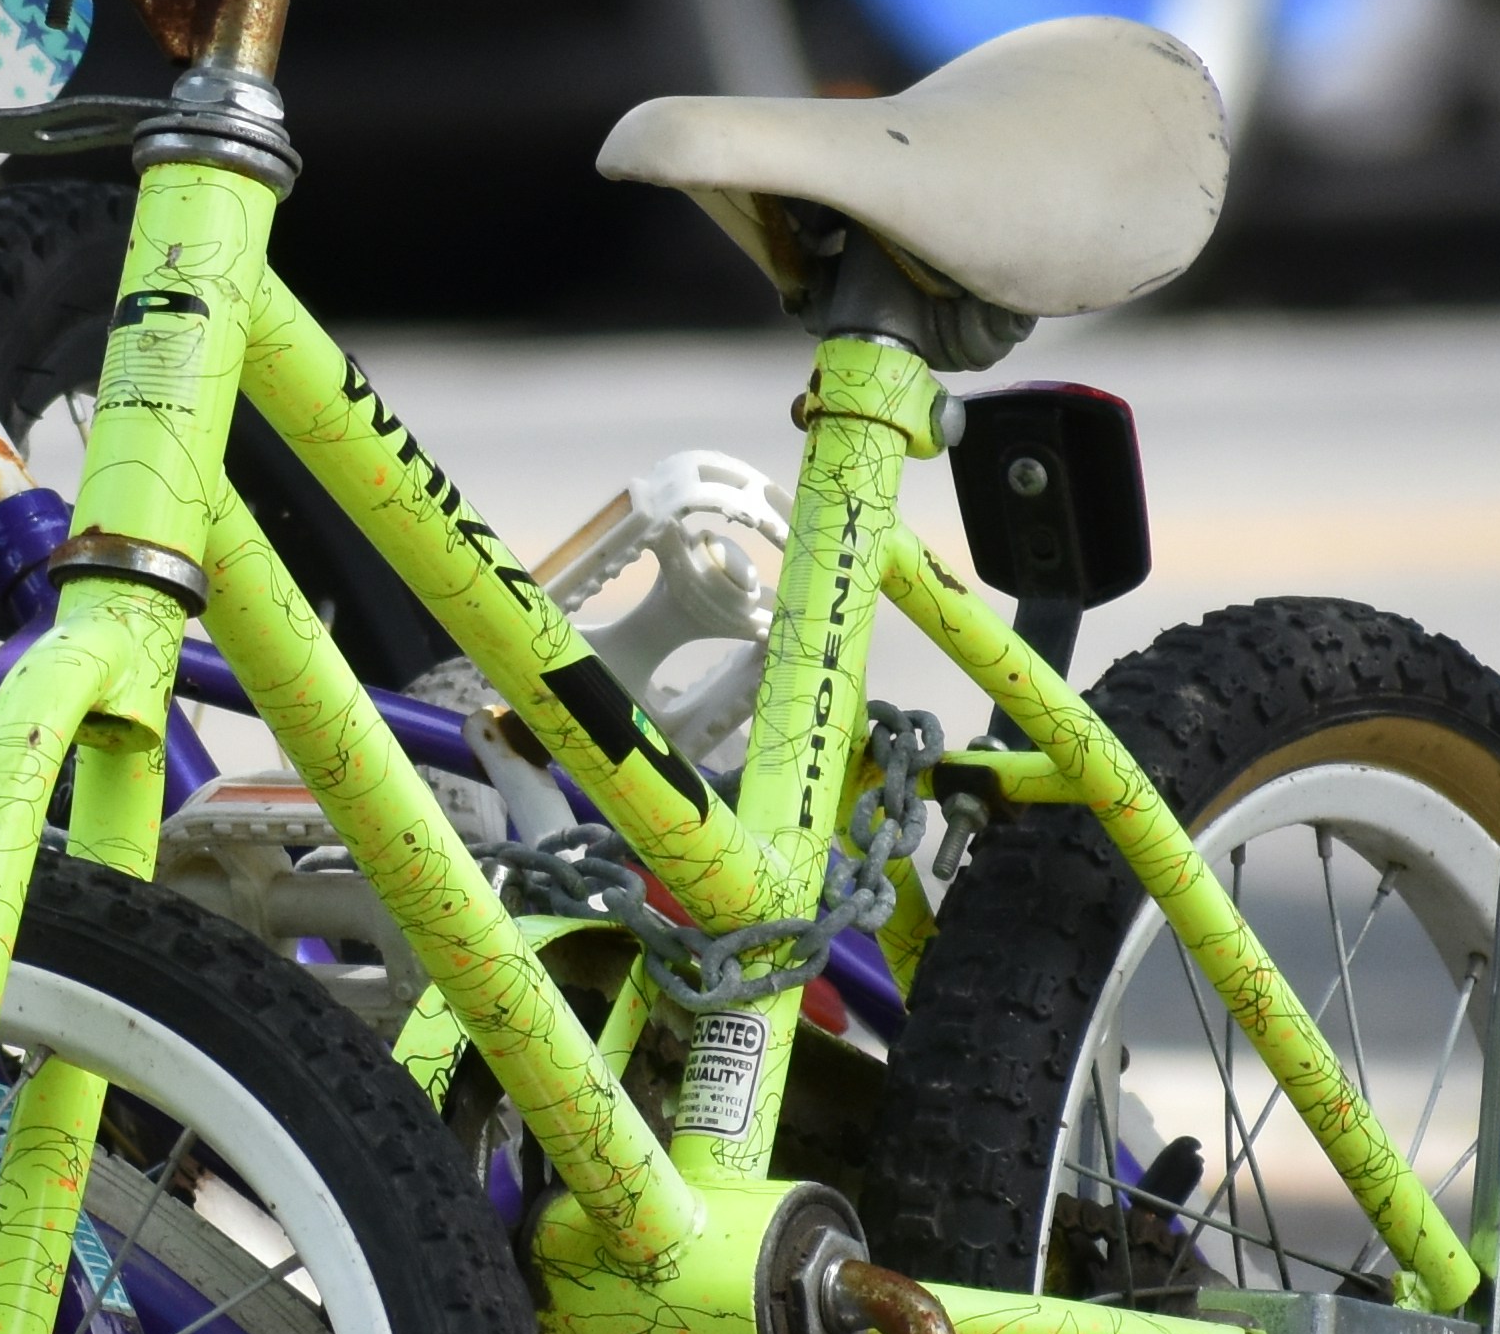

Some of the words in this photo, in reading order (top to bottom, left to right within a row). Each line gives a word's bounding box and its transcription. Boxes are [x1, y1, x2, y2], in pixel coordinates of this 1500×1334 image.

[798, 496, 865, 830] PHOENIX
[701, 1054, 753, 1071] APPROVED
[685, 1066, 745, 1086] QUALITY
